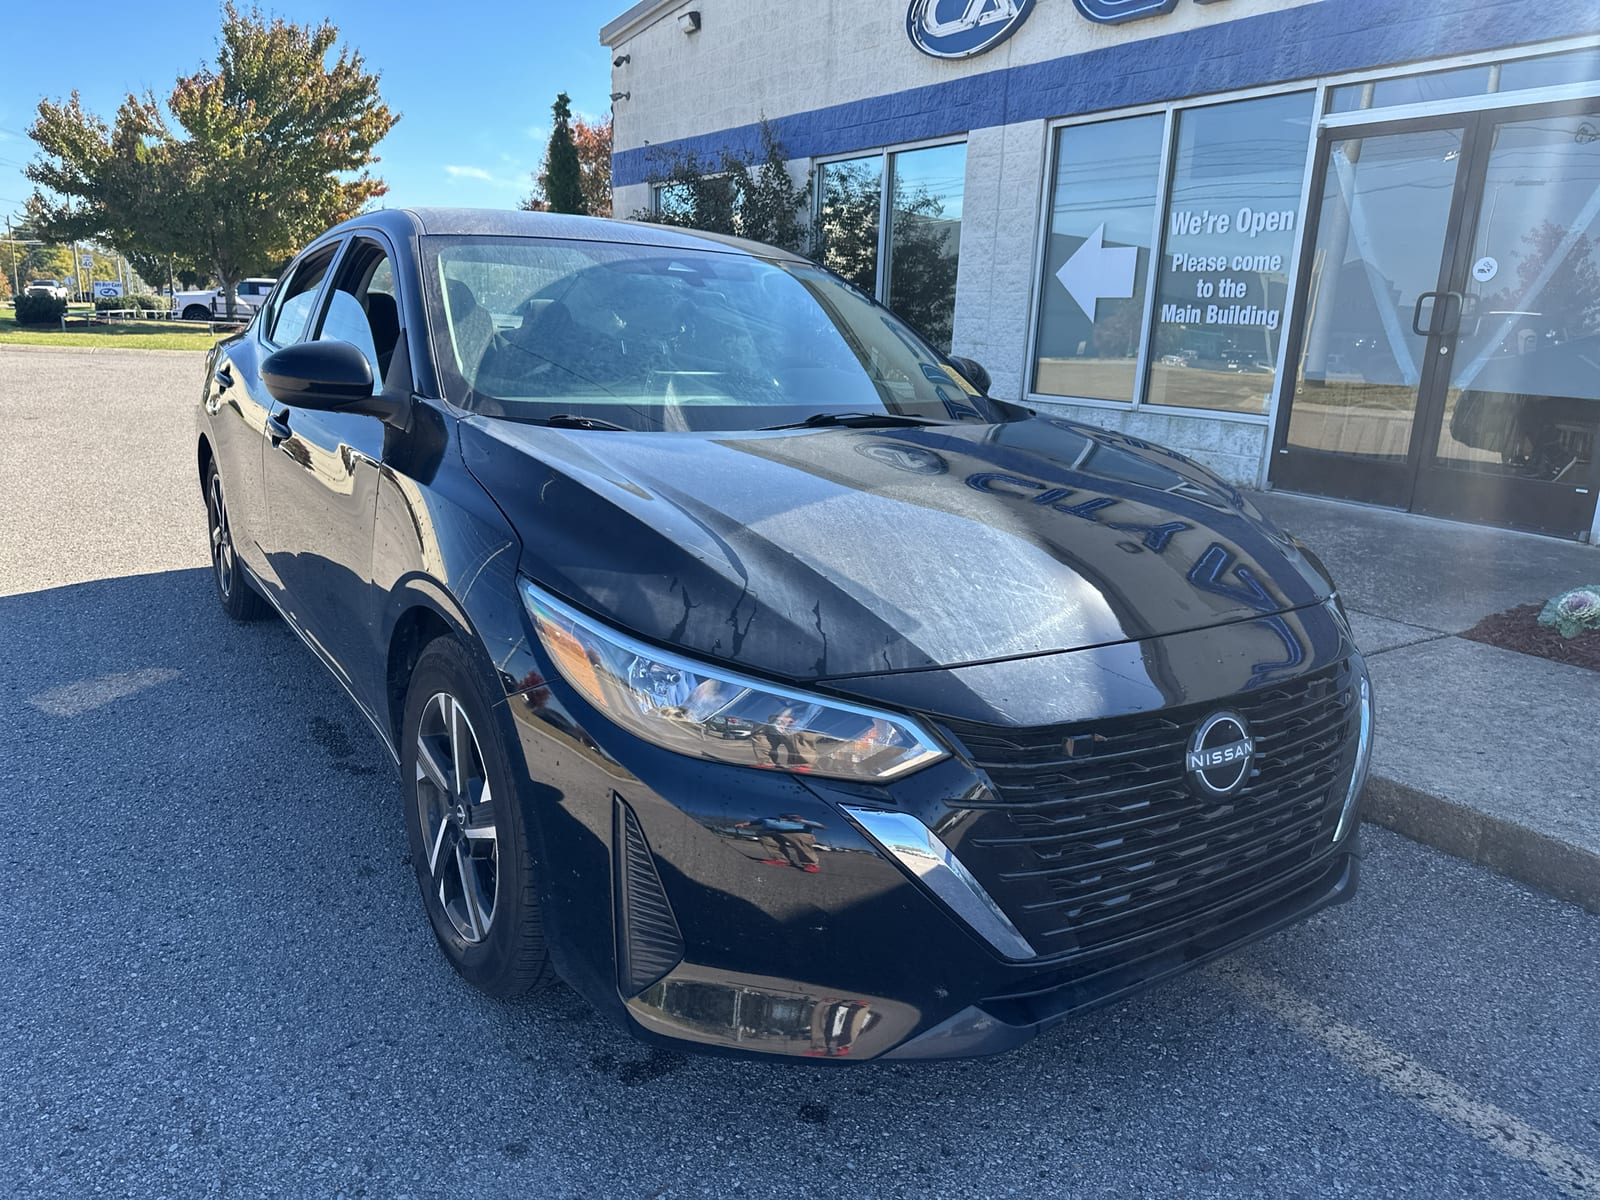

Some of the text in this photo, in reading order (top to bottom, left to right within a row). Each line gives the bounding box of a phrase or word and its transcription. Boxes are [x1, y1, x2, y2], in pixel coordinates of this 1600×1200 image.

[1171, 207, 1295, 238] We're Open
[1171, 253, 1281, 272] Please come
[1196, 278, 1247, 298] to the
[1161, 304, 1279, 330] Main Building
[1190, 740, 1252, 768] NISSAN
